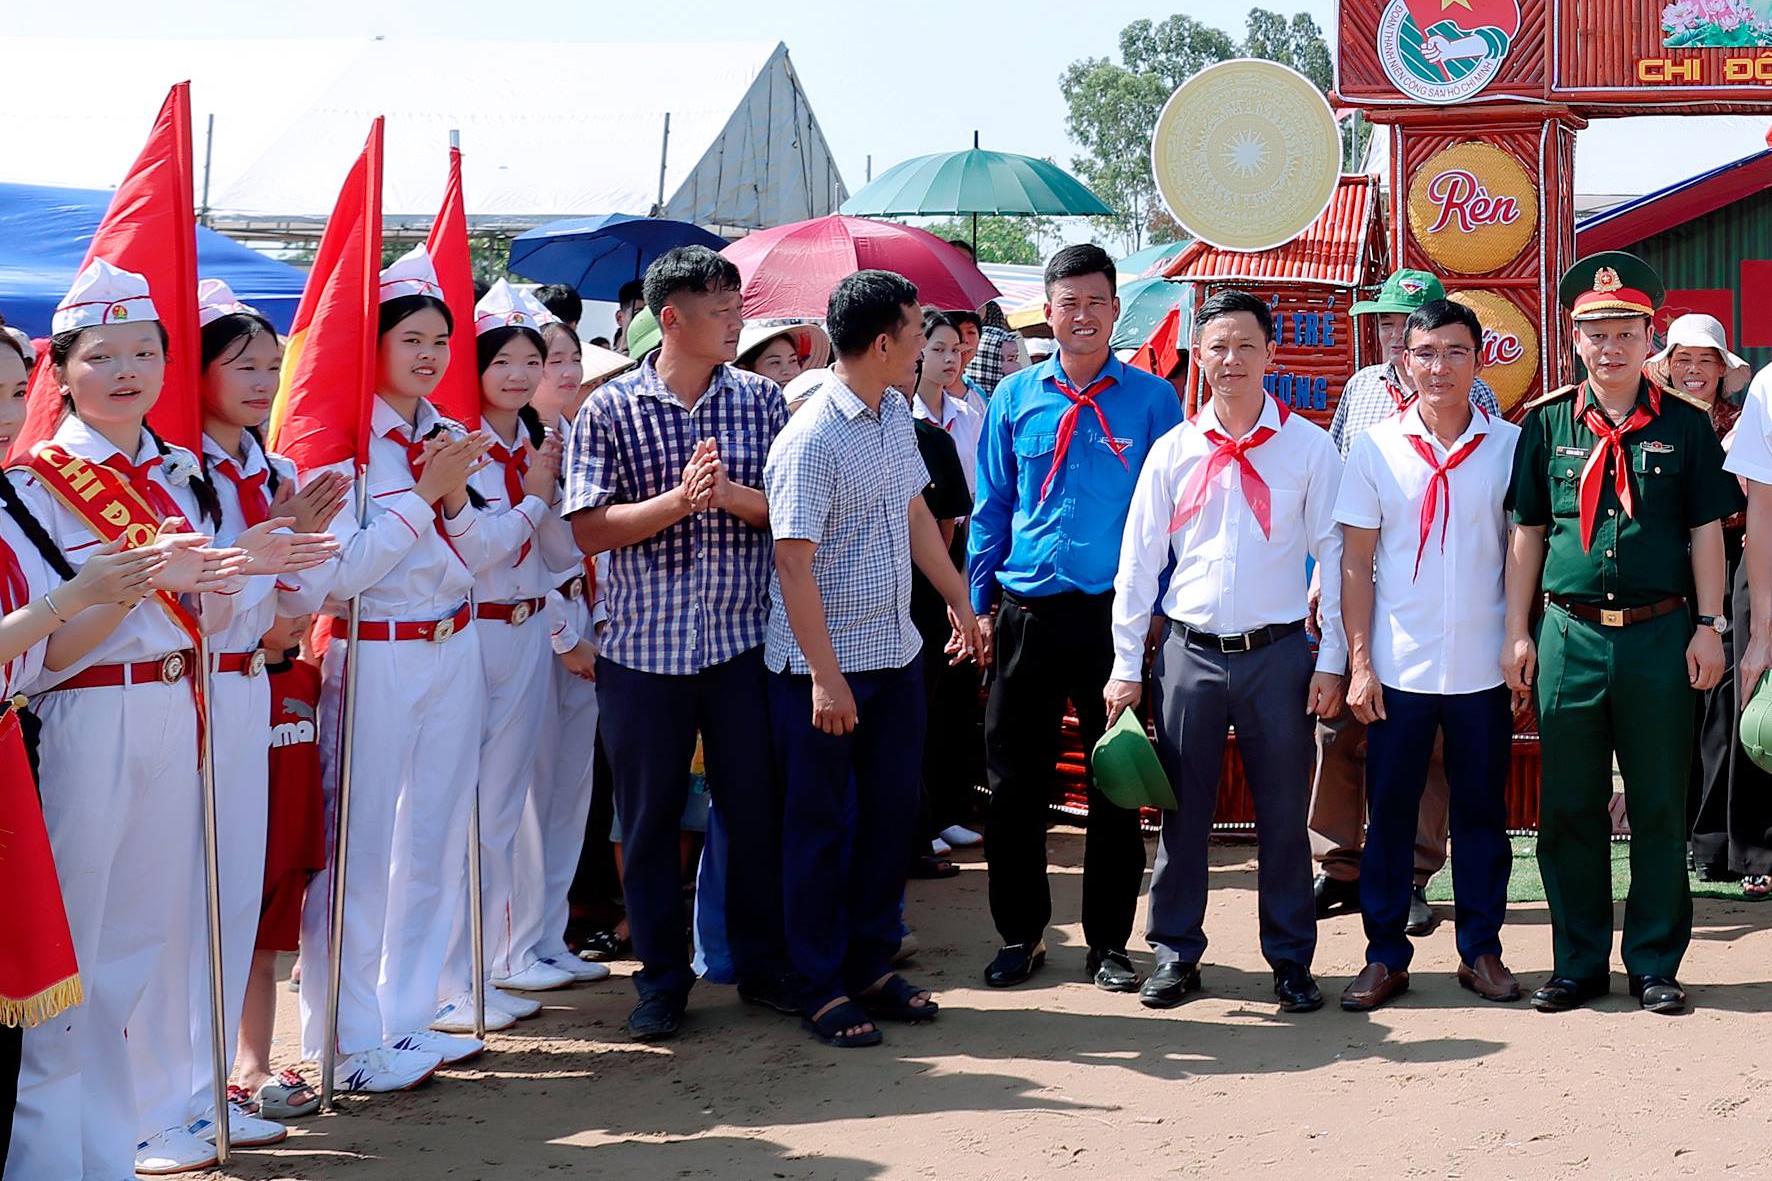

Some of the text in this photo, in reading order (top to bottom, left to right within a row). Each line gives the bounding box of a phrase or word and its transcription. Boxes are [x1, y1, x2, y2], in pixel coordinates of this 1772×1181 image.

[1384, 27, 1396, 61] THANH
[1475, 61, 1494, 82] MINH
[1637, 58, 1701, 82] CHI
[1427, 169, 1520, 233] Rèn
[1292, 295, 1336, 347] TRẺ
[39, 448, 157, 549] CHI ĐỘ
